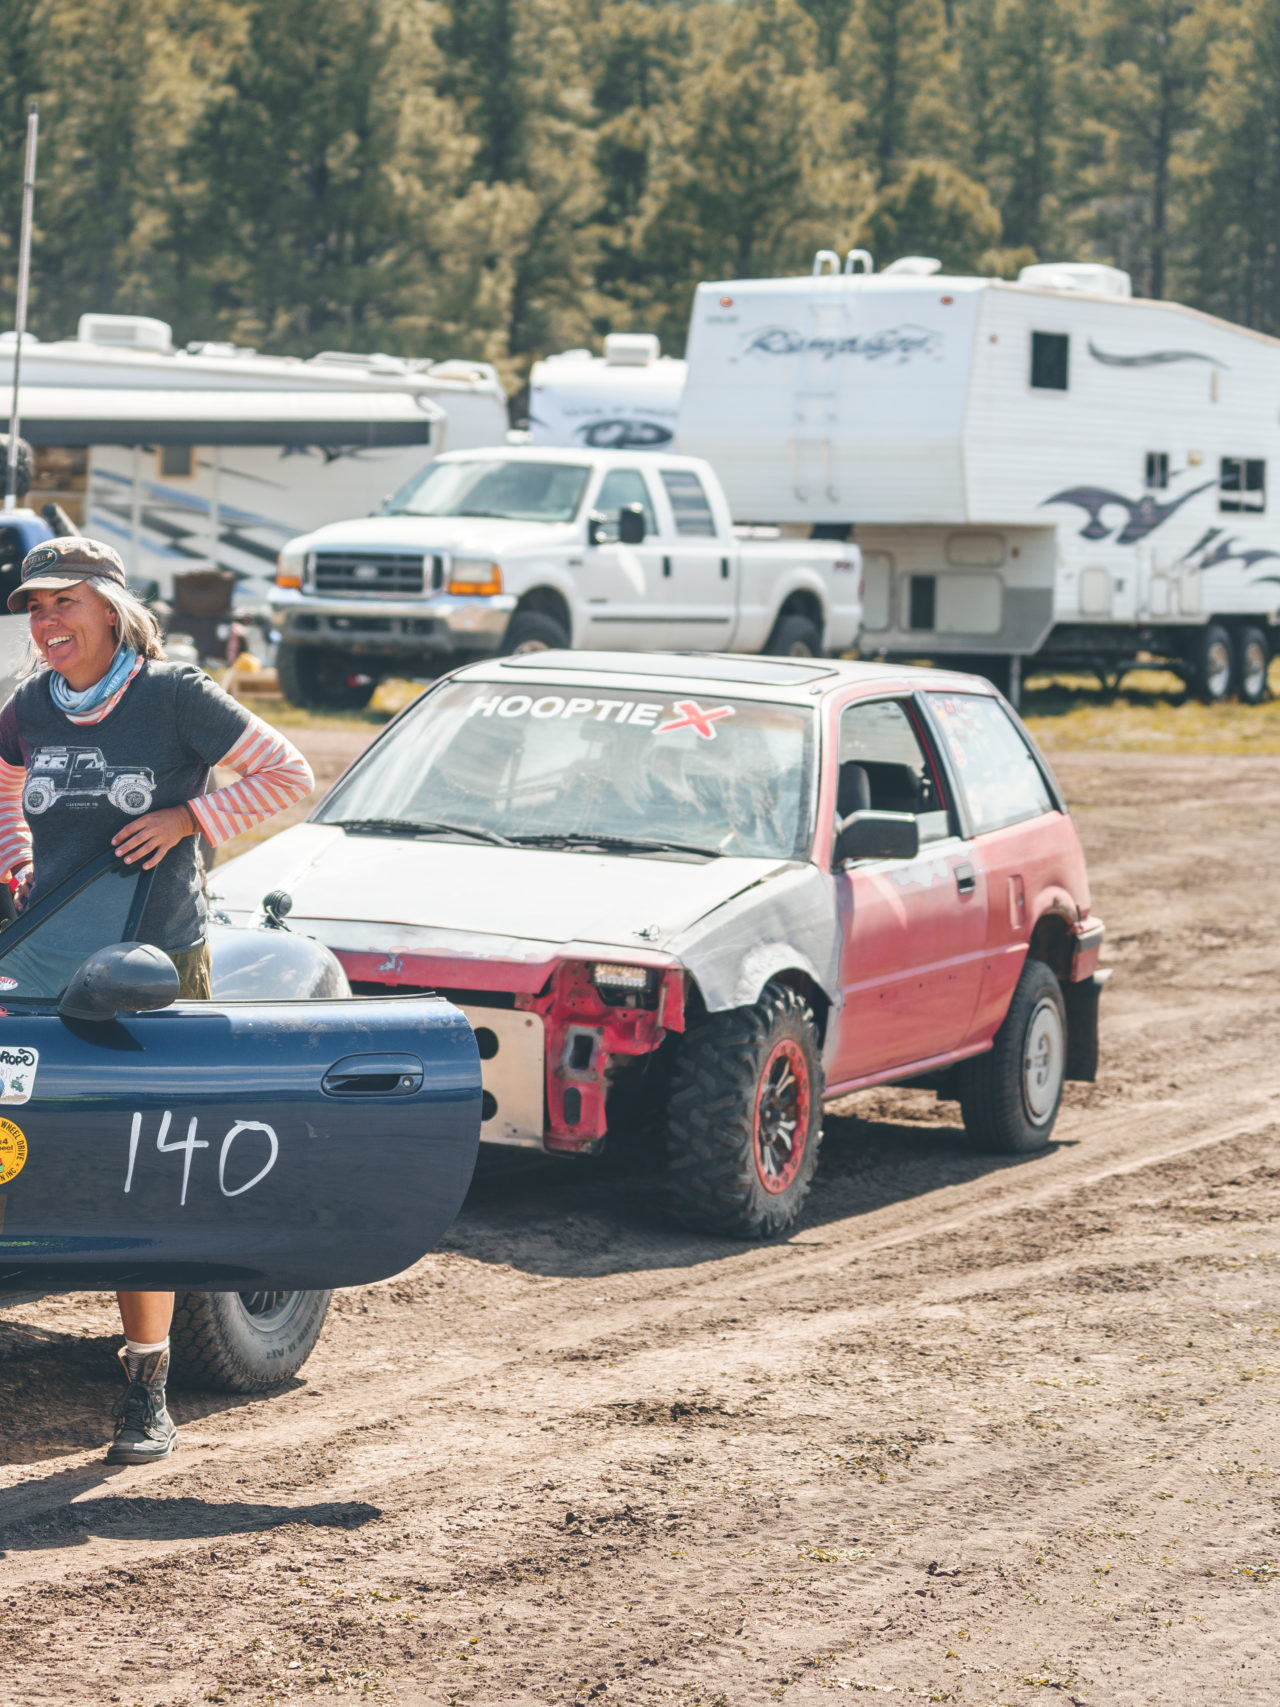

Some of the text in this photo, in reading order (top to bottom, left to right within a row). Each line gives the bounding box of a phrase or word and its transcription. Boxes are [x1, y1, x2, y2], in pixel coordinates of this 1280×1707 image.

[466, 695, 736, 741] HOOPTIE X
[0, 1120, 21, 1141] WHEEL
[16, 1140, 26, 1162] DRIVE
[124, 1110, 279, 1206] 140
